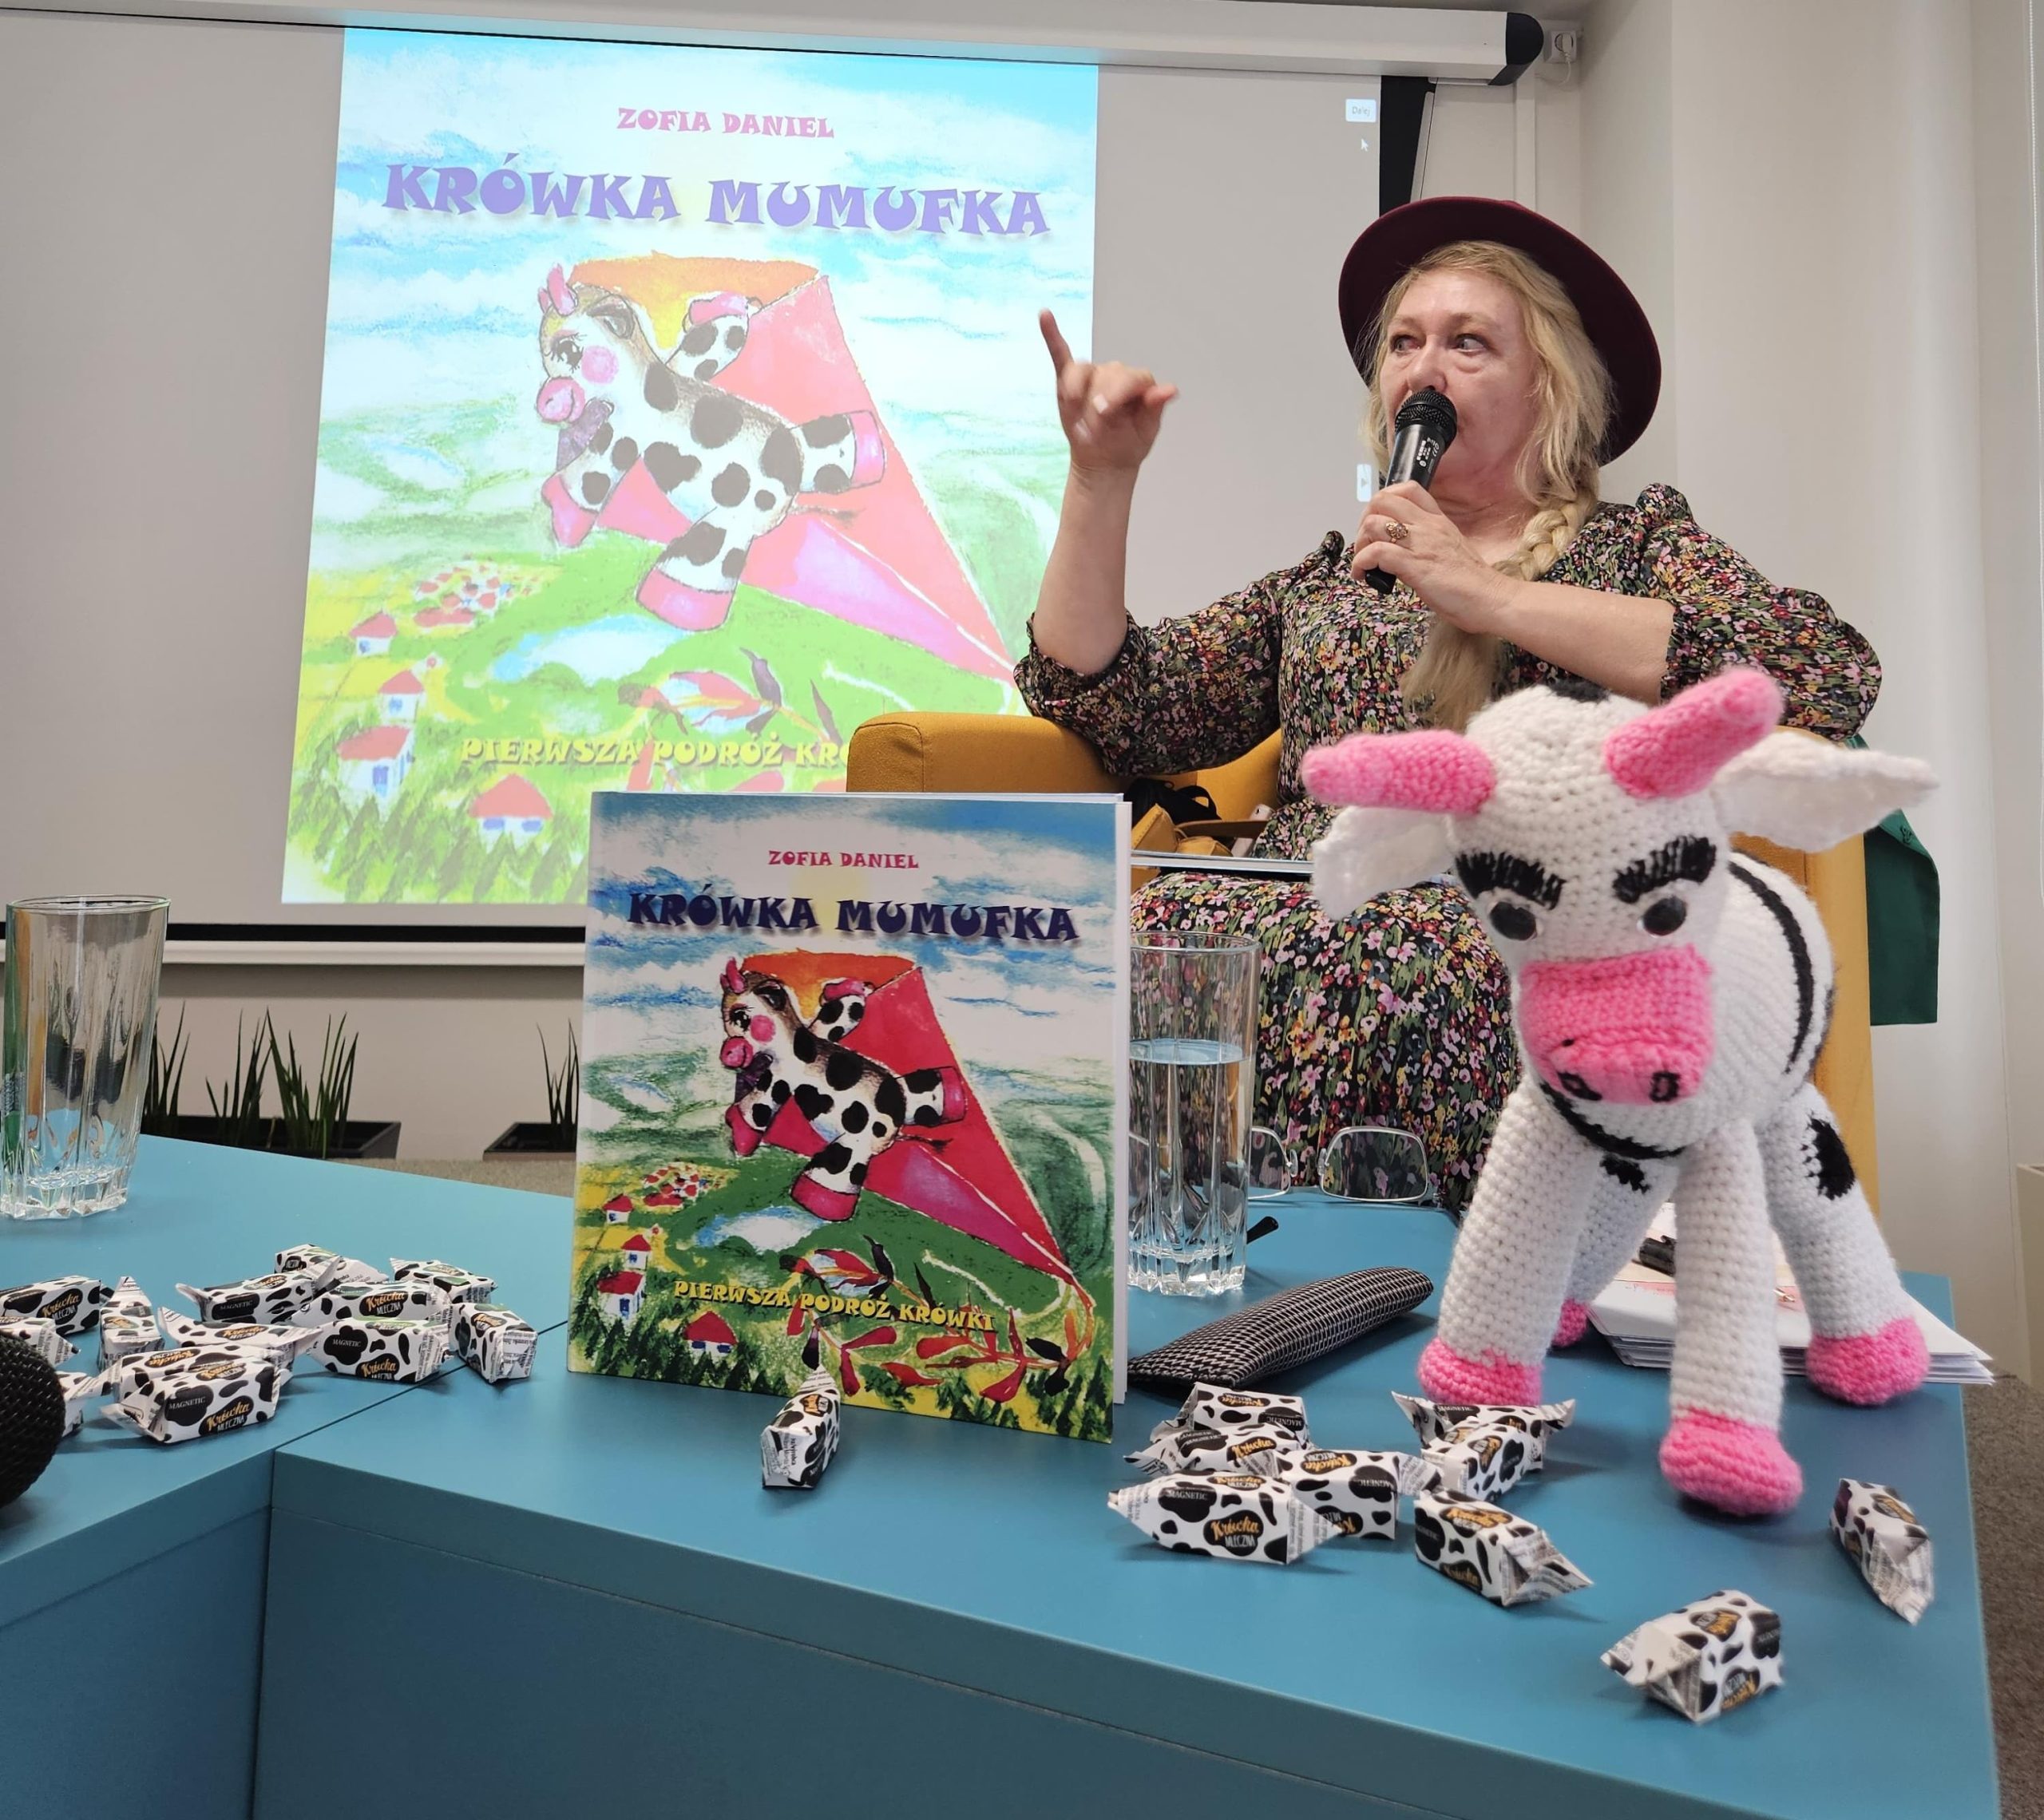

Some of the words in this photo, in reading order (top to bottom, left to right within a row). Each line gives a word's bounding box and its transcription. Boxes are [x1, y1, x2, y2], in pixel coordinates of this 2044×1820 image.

[616, 107, 712, 135] ZOFIA
[721, 112, 835, 139] DANIEL
[382, 152, 682, 220] KRÓWKA
[704, 179, 1052, 236] MUMUFKA
[460, 737, 640, 767] PIERWSZA
[652, 731, 784, 769] PODRÓŻ
[768, 849, 833, 868] ZOFIA
[840, 852, 920, 869] DANIEL
[627, 883, 819, 930] KRÓWKA
[834, 899, 1080, 942] MUMUFKA
[220, 1300, 253, 1310] MAGNETIC
[673, 1280, 793, 1308] PIERWSZA
[799, 1292, 891, 1320] PODRÓŻ
[899, 1301, 997, 1331] KRÓWKI
[332, 1339, 362, 1347] MAGNETIC
[168, 1396, 206, 1410] MAGNETIC
[1168, 1490, 1209, 1501] MAGNETIC
